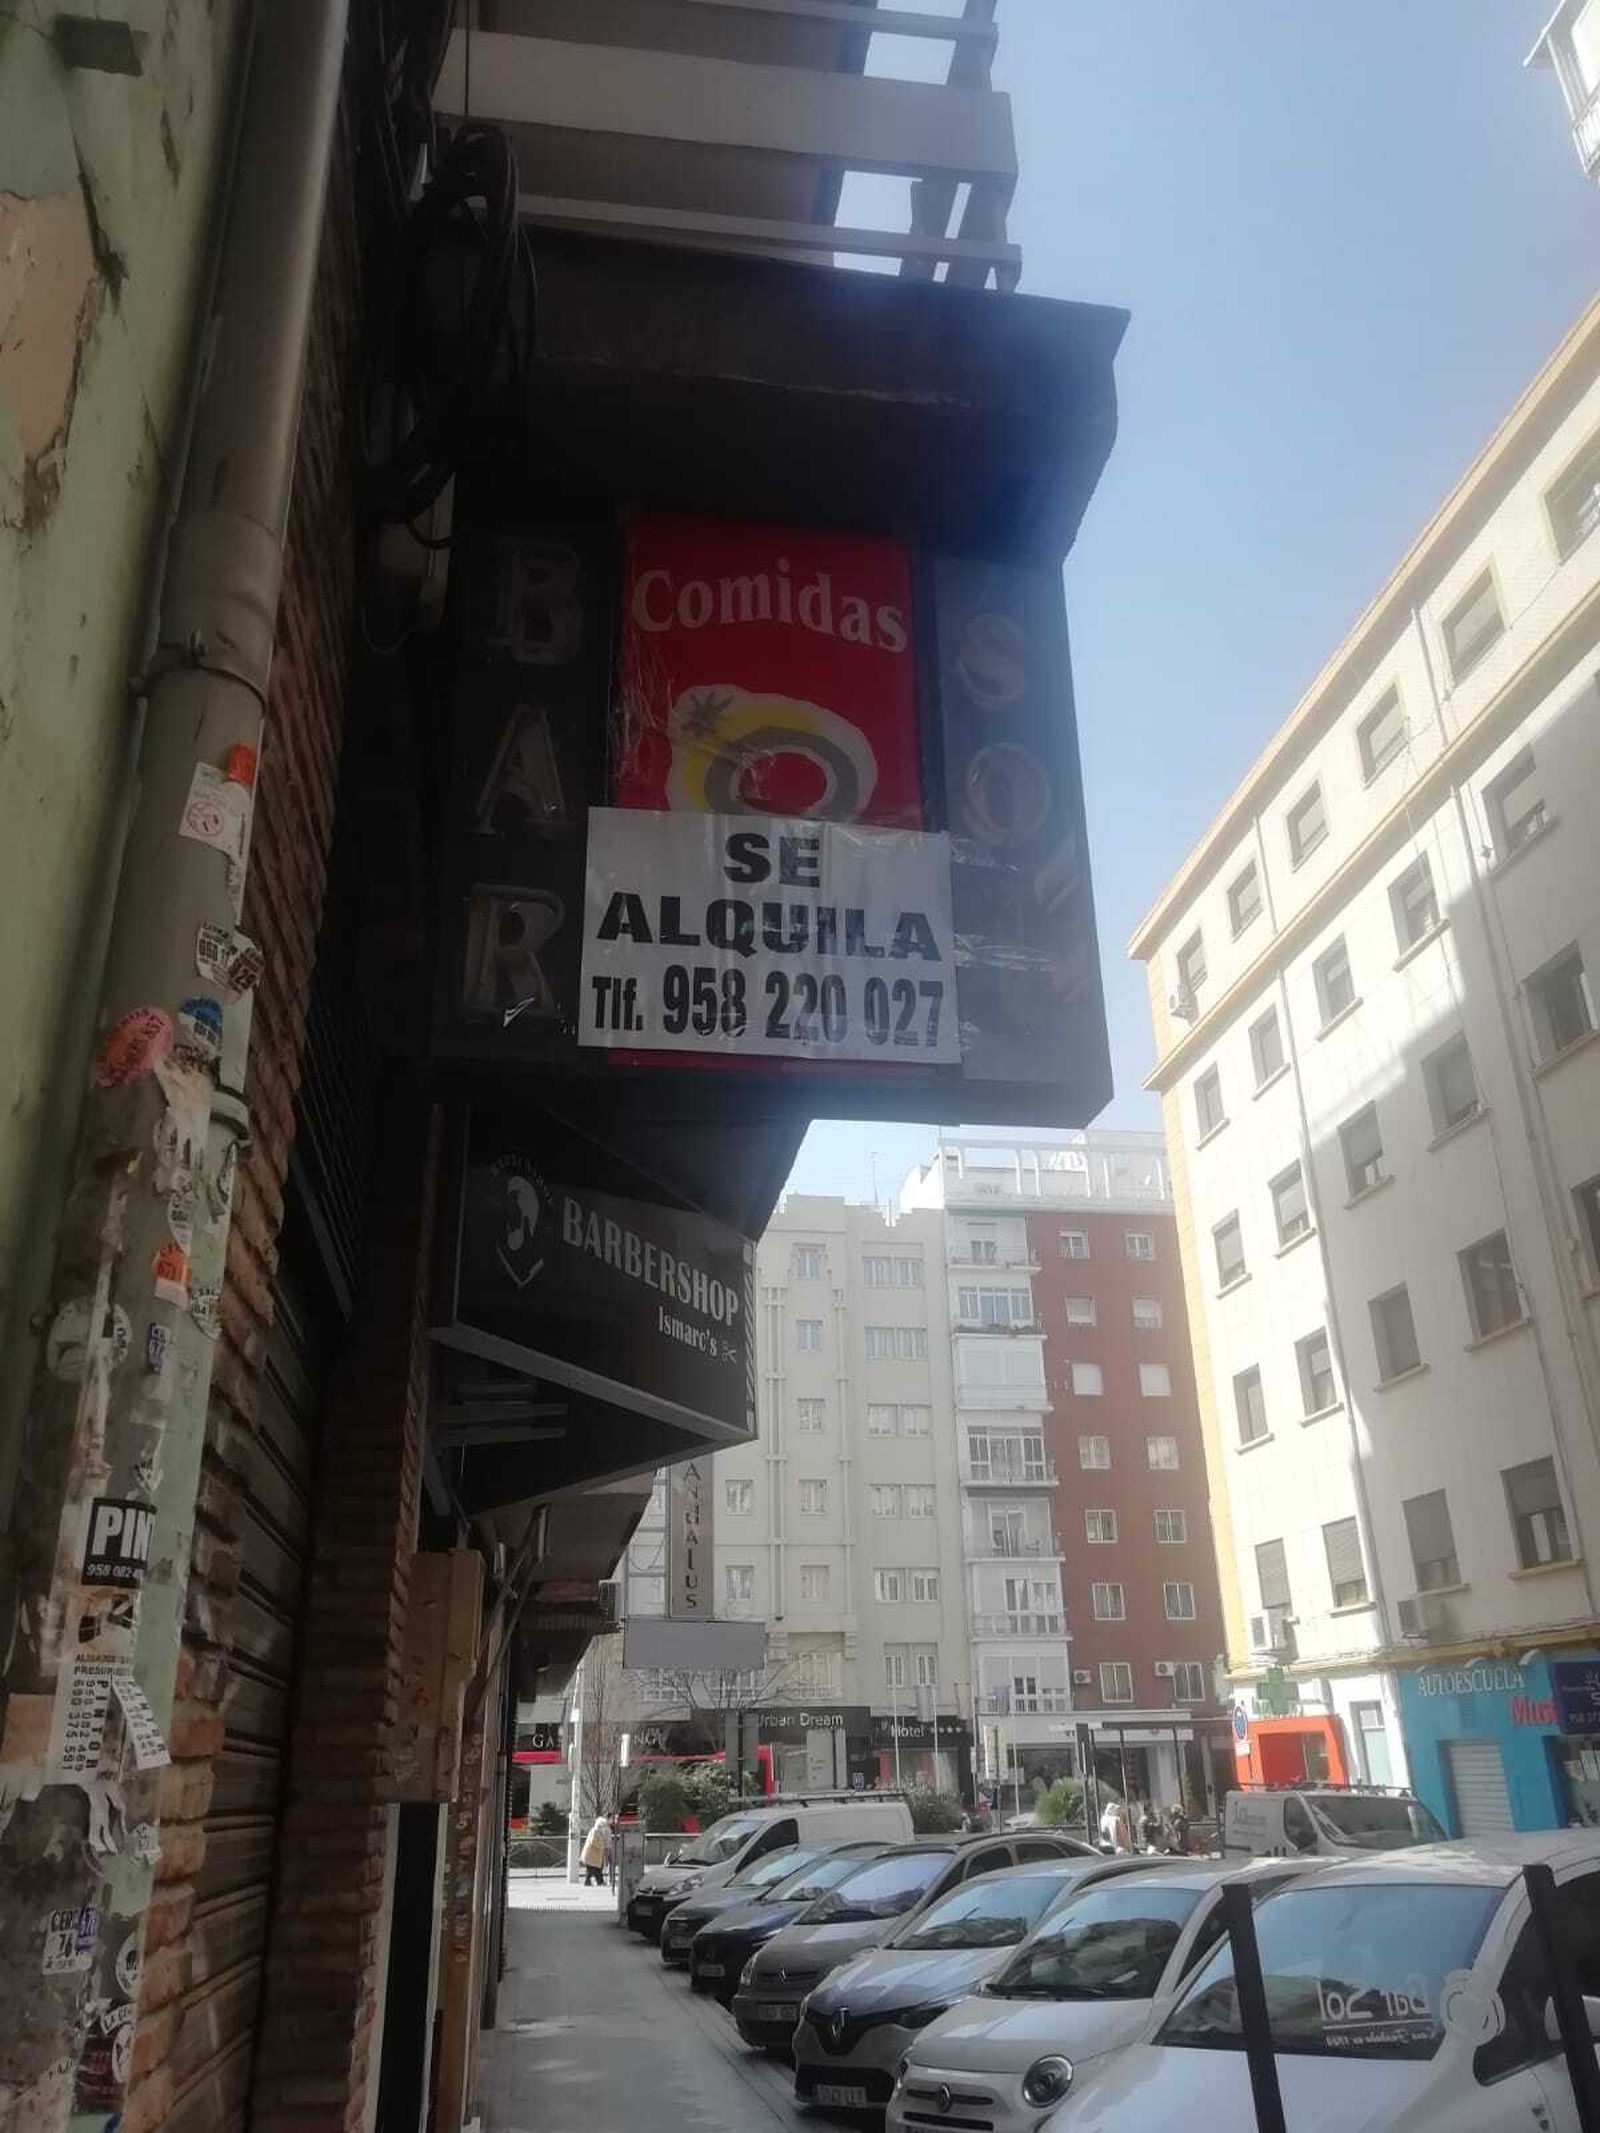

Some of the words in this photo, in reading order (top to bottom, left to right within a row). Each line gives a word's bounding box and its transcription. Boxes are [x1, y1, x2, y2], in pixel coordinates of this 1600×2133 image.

[630, 556, 909, 653] Comidas
[461, 538, 584, 1022] BAR
[722, 832, 821, 888] SE
[596, 892, 942, 962] ALQUILA
[592, 974, 645, 1031] Tlf.
[661, 964, 748, 1035] 958
[764, 969, 848, 1047] 220
[864, 975, 945, 1048] 027
[562, 1195, 740, 1327] BARBERSHOP
[1418, 1664, 1526, 1697] AUTOESCUELA
[85, 1679, 109, 1769] PINTOR
[799, 1712, 844, 1729] Dream
[891, 1725, 925, 1738] Hotel
